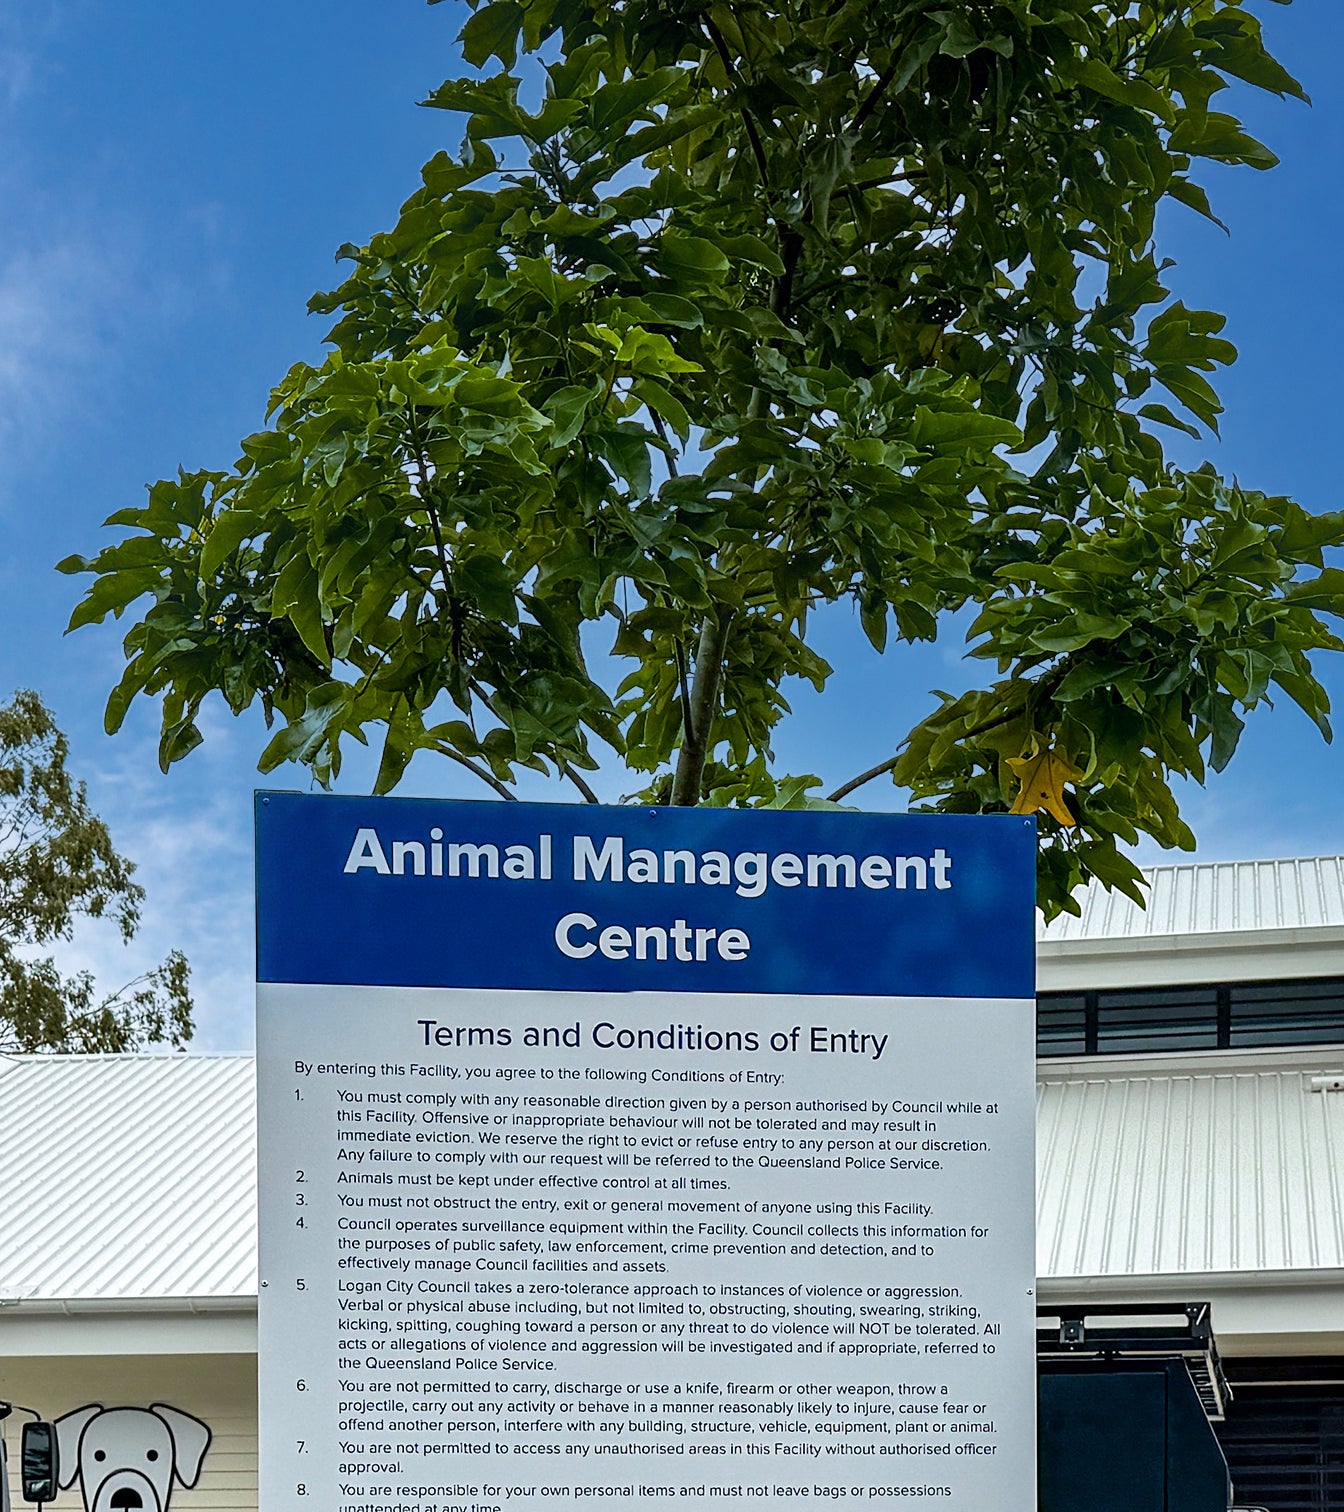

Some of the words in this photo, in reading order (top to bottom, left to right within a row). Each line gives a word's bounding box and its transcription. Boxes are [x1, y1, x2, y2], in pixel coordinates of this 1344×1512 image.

[344, 828, 551, 879] Animal
[574, 836, 951, 897] Management
[556, 913, 749, 961] Centre
[417, 1019, 512, 1047] Terms
[523, 1021, 580, 1048] and
[592, 1022, 759, 1052] Conditions
[770, 1026, 801, 1052] of
[810, 1027, 889, 1060] Entry
[294, 1060, 314, 1077] By
[316, 1062, 376, 1078] entering
[380, 1063, 406, 1076] this
[410, 1063, 462, 1080] Facility,
[464, 1067, 491, 1081] you
[495, 1068, 537, 1082] agree
[540, 1067, 554, 1080] to
[557, 1067, 581, 1080] the
[584, 1067, 647, 1085] following
[651, 1068, 725, 1083] Conditions
[728, 1070, 744, 1083] of
[746, 1070, 785, 1087] Entry:
[294, 1088, 304, 1101] 1.
[336, 1089, 363, 1103] You
[367, 1091, 402, 1104] must
[405, 1092, 457, 1108] comply
[460, 1093, 490, 1106] with
[493, 1095, 520, 1109] any
[523, 1094, 601, 1108] reasonable
[604, 1095, 665, 1109] direction
[669, 1097, 707, 1112] given
[711, 1097, 728, 1113] by
[731, 1100, 740, 1111] a
[744, 1100, 792, 1113] person
[795, 1099, 868, 1112] authorised
[871, 1099, 889, 1116] by
[891, 1100, 943, 1114] Council
[946, 1101, 982, 1114] while
[985, 1103, 999, 1114] at
[295, 1169, 309, 1183] 2.
[336, 1170, 394, 1185] Animals
[397, 1173, 432, 1186] must
[436, 1173, 455, 1186] be
[458, 1173, 490, 1189] kept
[493, 1175, 535, 1187] under
[538, 1174, 599, 1188] effective
[602, 1176, 650, 1189] control
[654, 1177, 668, 1189] at
[671, 1176, 687, 1190] all
[689, 1177, 731, 1190] times.
[337, 1255, 411, 1273] effectively
[414, 1259, 472, 1273] manage
[475, 1257, 528, 1271] Council
[532, 1258, 589, 1272] facilities
[592, 1260, 619, 1272] and
[622, 1261, 670, 1273] assets.
[296, 1278, 309, 1291] 5.
[338, 1279, 382, 1295] Logan
[386, 1279, 414, 1296] City
[417, 1279, 471, 1293] Council
[474, 1280, 513, 1294] takes
[516, 1284, 525, 1294] a
[528, 1282, 630, 1295] zero-tolerance
[633, 1283, 699, 1298] approach
[702, 1285, 717, 1296] to
[720, 1283, 785, 1297] instances
[788, 1283, 804, 1297] of
[805, 1284, 863, 1297] violence
[866, 1287, 881, 1298] or
[884, 1285, 963, 1301] aggression.
[338, 1417, 384, 1431] offend
[388, 1418, 444, 1432] another
[447, 1421, 500, 1434] person,
[504, 1419, 563, 1432] interfere
[566, 1419, 596, 1432] with
[599, 1422, 625, 1435] any
[628, 1419, 687, 1436] building,
[690, 1420, 755, 1434] structure,
[758, 1420, 811, 1435] vehicle,
[814, 1420, 891, 1436] equipment,
[895, 1420, 929, 1436] plant
[932, 1423, 947, 1433] or
[950, 1420, 998, 1433] animal.
[338, 1460, 404, 1476] approval.
